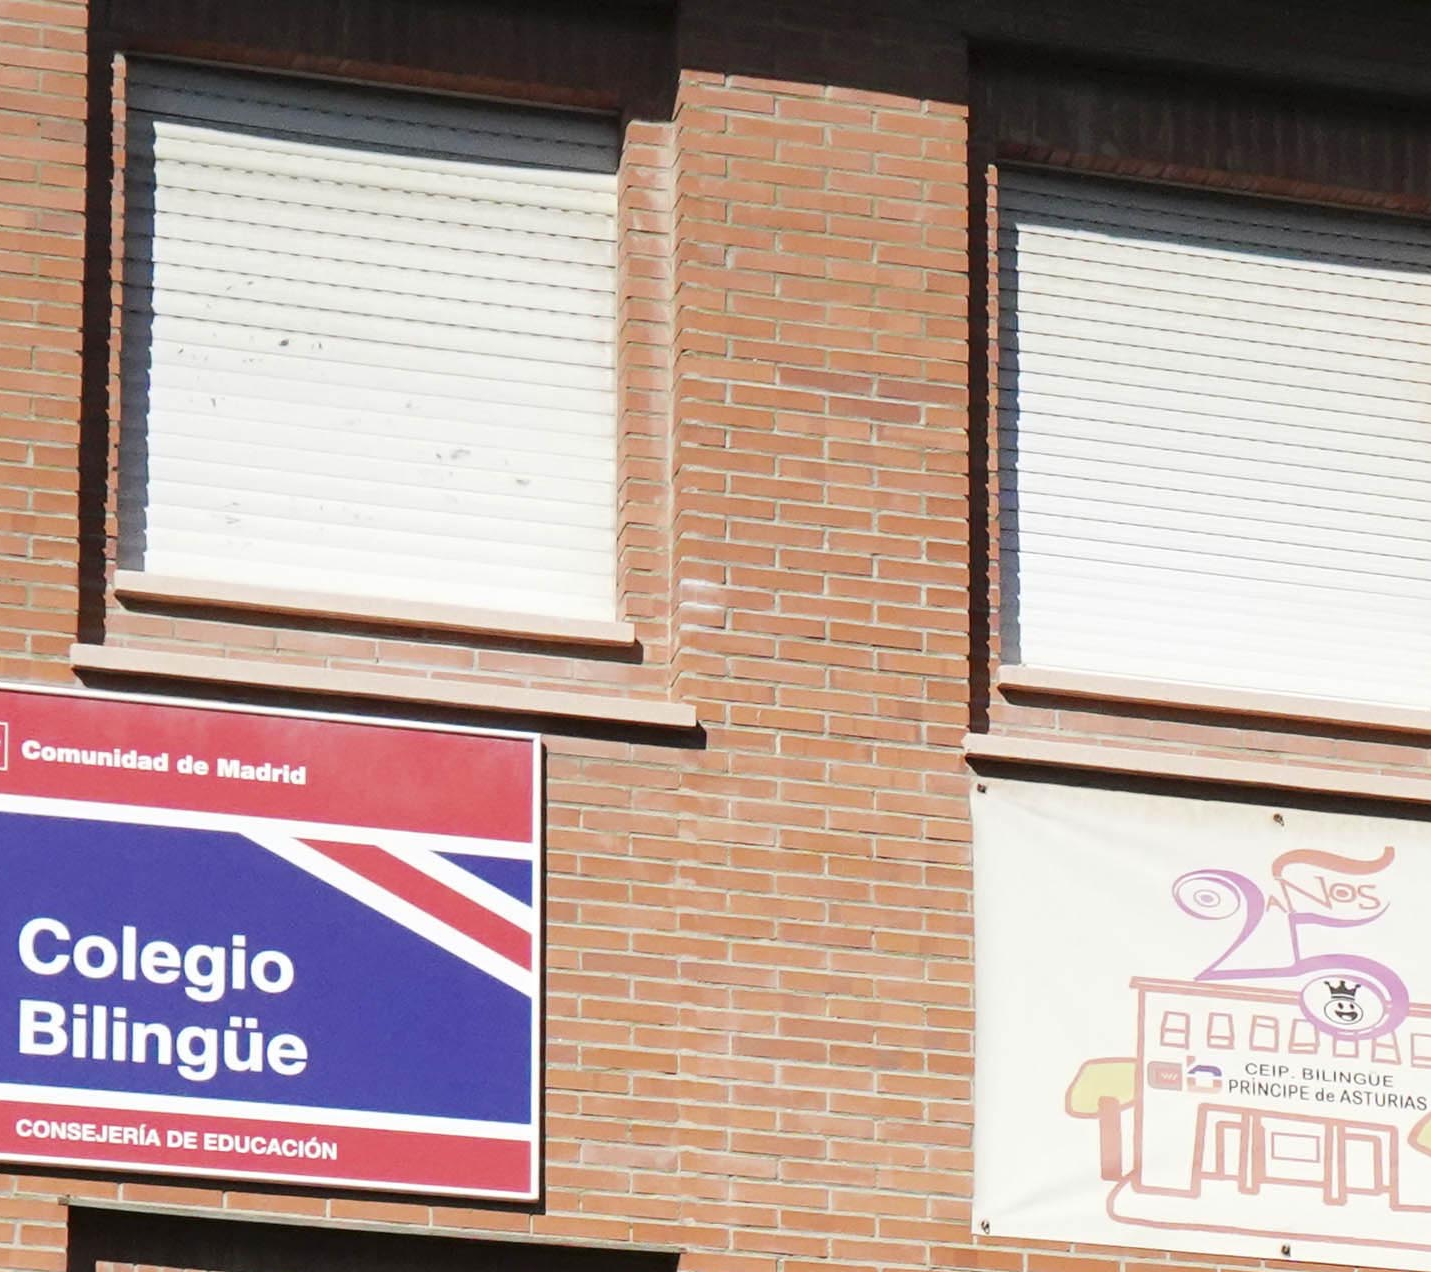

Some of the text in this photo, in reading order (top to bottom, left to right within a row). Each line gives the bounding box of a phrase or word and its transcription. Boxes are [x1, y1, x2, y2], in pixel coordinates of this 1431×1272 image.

[21, 740, 306, 785] Comunidad de Madrid
[18, 917, 295, 1003] Colegio
[1172, 869, 1410, 1041] 25
[18, 999, 308, 1082] Bilingüe
[1315, 1088, 1335, 1102] de
[1340, 1089, 1428, 1111] ASTURIAS
[15, 1119, 338, 1160] CONSEJERÍA DE EDUCACIÓN
